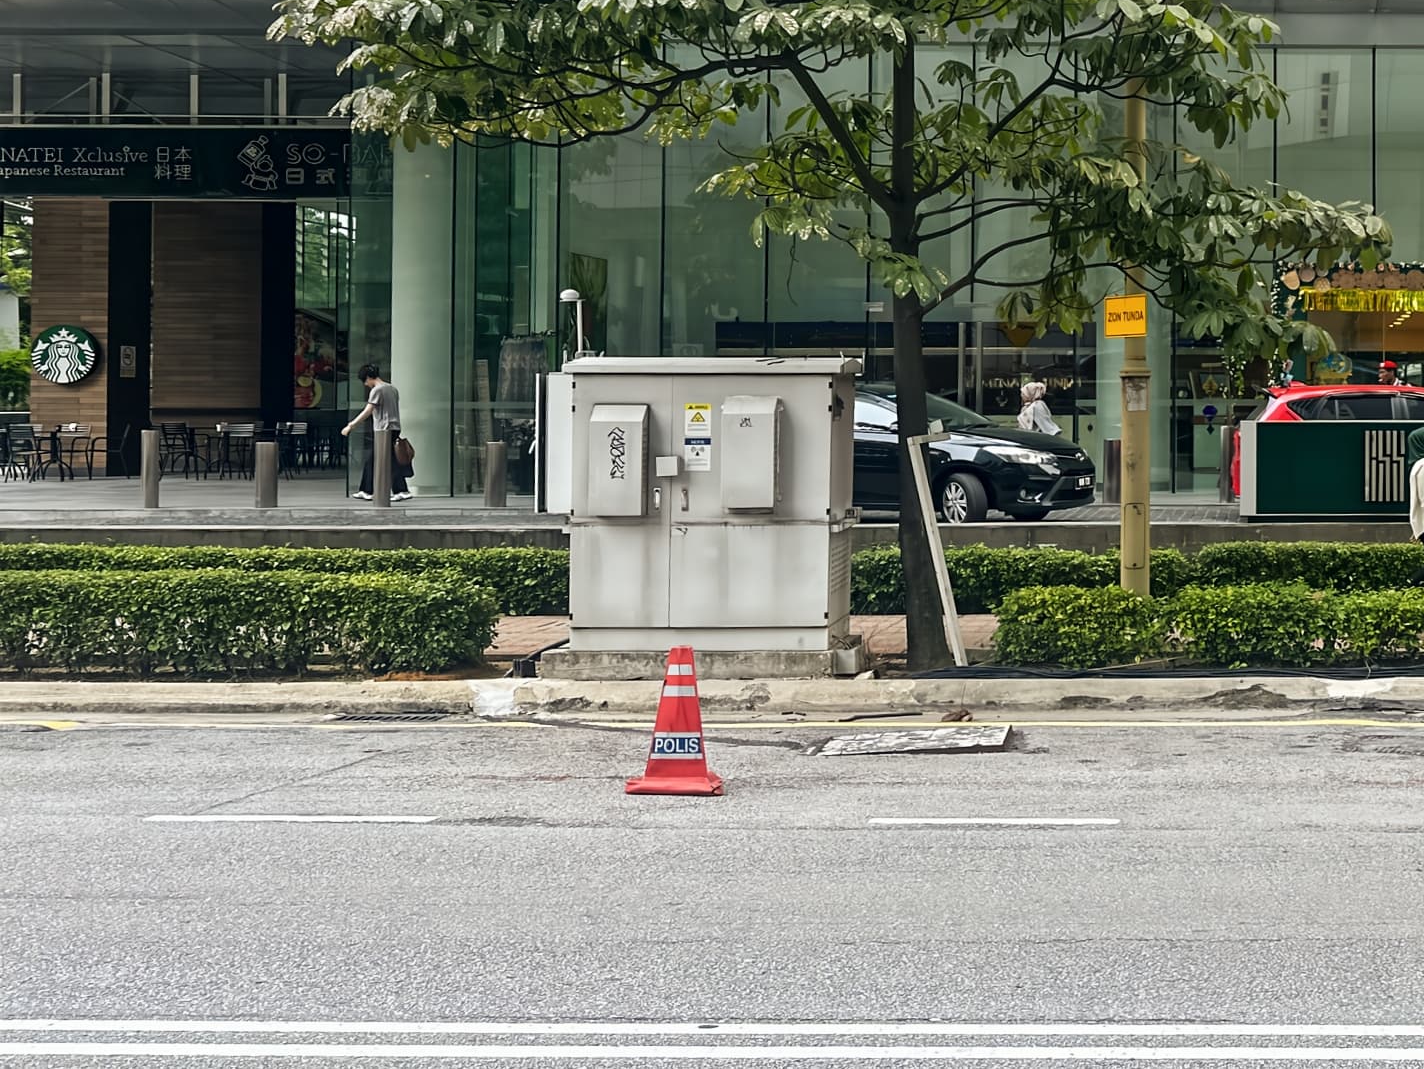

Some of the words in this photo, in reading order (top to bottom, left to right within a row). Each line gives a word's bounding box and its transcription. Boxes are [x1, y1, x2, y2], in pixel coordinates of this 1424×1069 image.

[0, 147, 64, 162] NATEI
[72, 145, 148, 163] Xclusive
[156, 146, 192, 162] 日本
[54, 164, 125, 176] Restaurant
[154, 164, 192, 180] 料理
[1108, 312, 1121, 322] ZON
[1123, 310, 1144, 321] TUNDA
[654, 738, 699, 753] POLIS
